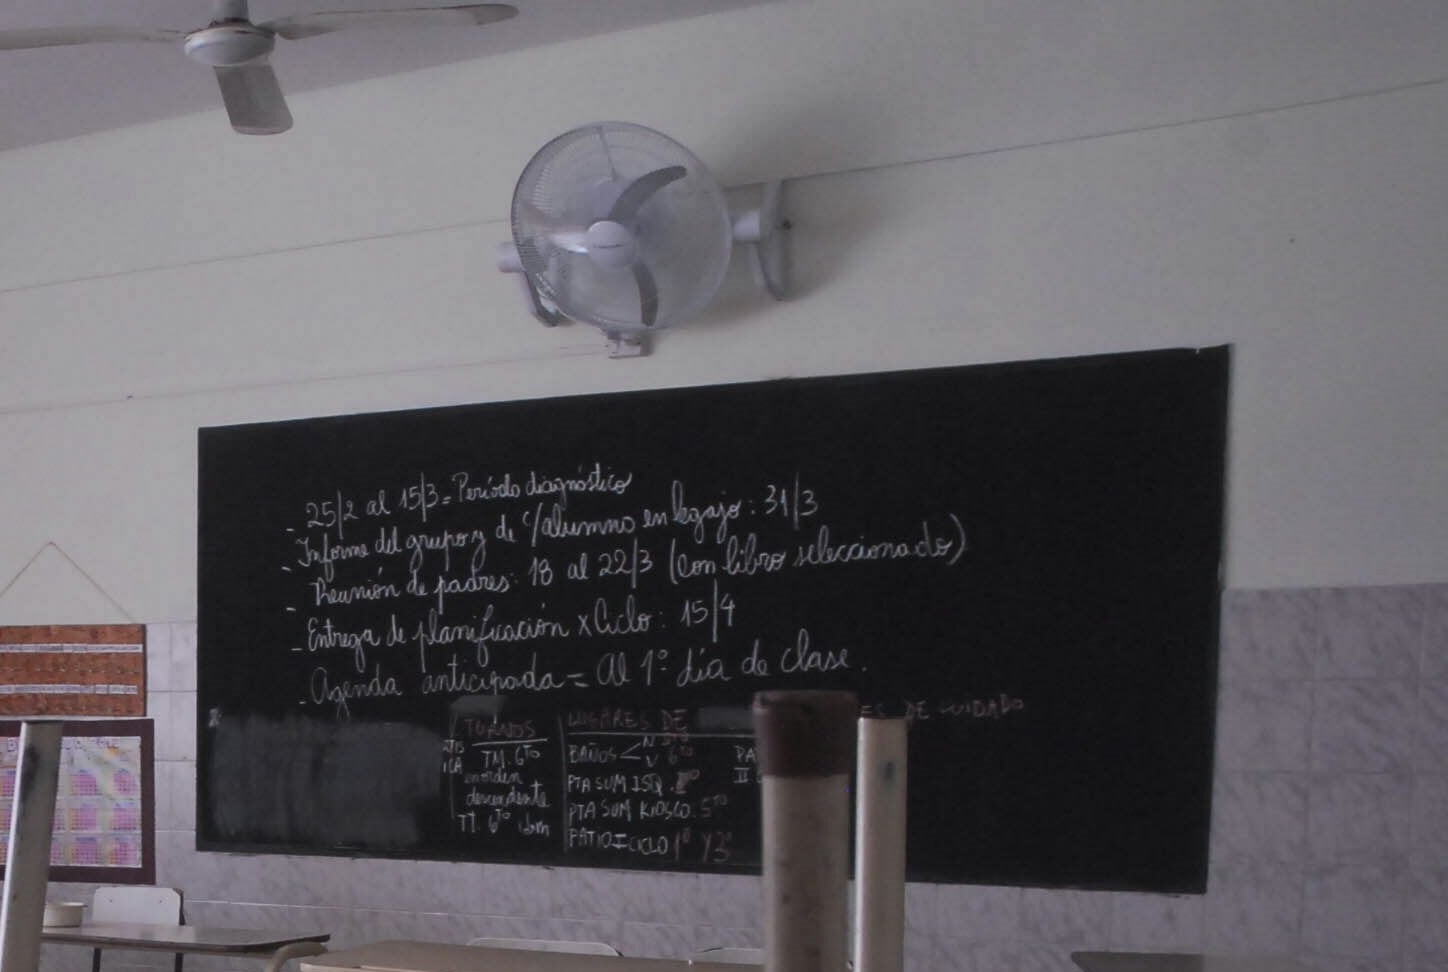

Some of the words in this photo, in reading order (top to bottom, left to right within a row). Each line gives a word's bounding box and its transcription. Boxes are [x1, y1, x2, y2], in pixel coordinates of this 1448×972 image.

[296, 532, 369, 583] Informe
[375, 526, 402, 554] del
[495, 514, 516, 543] de
[643, 507, 668, 528] en
[764, 472, 820, 531] 31/3
[306, 489, 359, 540] 25/2
[366, 489, 391, 515] al
[526, 462, 633, 510] diagnóstico
[311, 565, 400, 606] Reunión
[406, 568, 428, 596] de
[527, 556, 553, 587] 18
[567, 553, 589, 580] al
[598, 537, 654, 590] 22/3
[721, 532, 788, 577] libro
[307, 616, 381, 674] Entrega
[386, 613, 407, 648] de
[412, 603, 570, 674] planificación
[679, 579, 736, 643] 15/4
[310, 663, 403, 721] Agenda
[421, 652, 565, 700] anticipada
[741, 638, 770, 677] de
